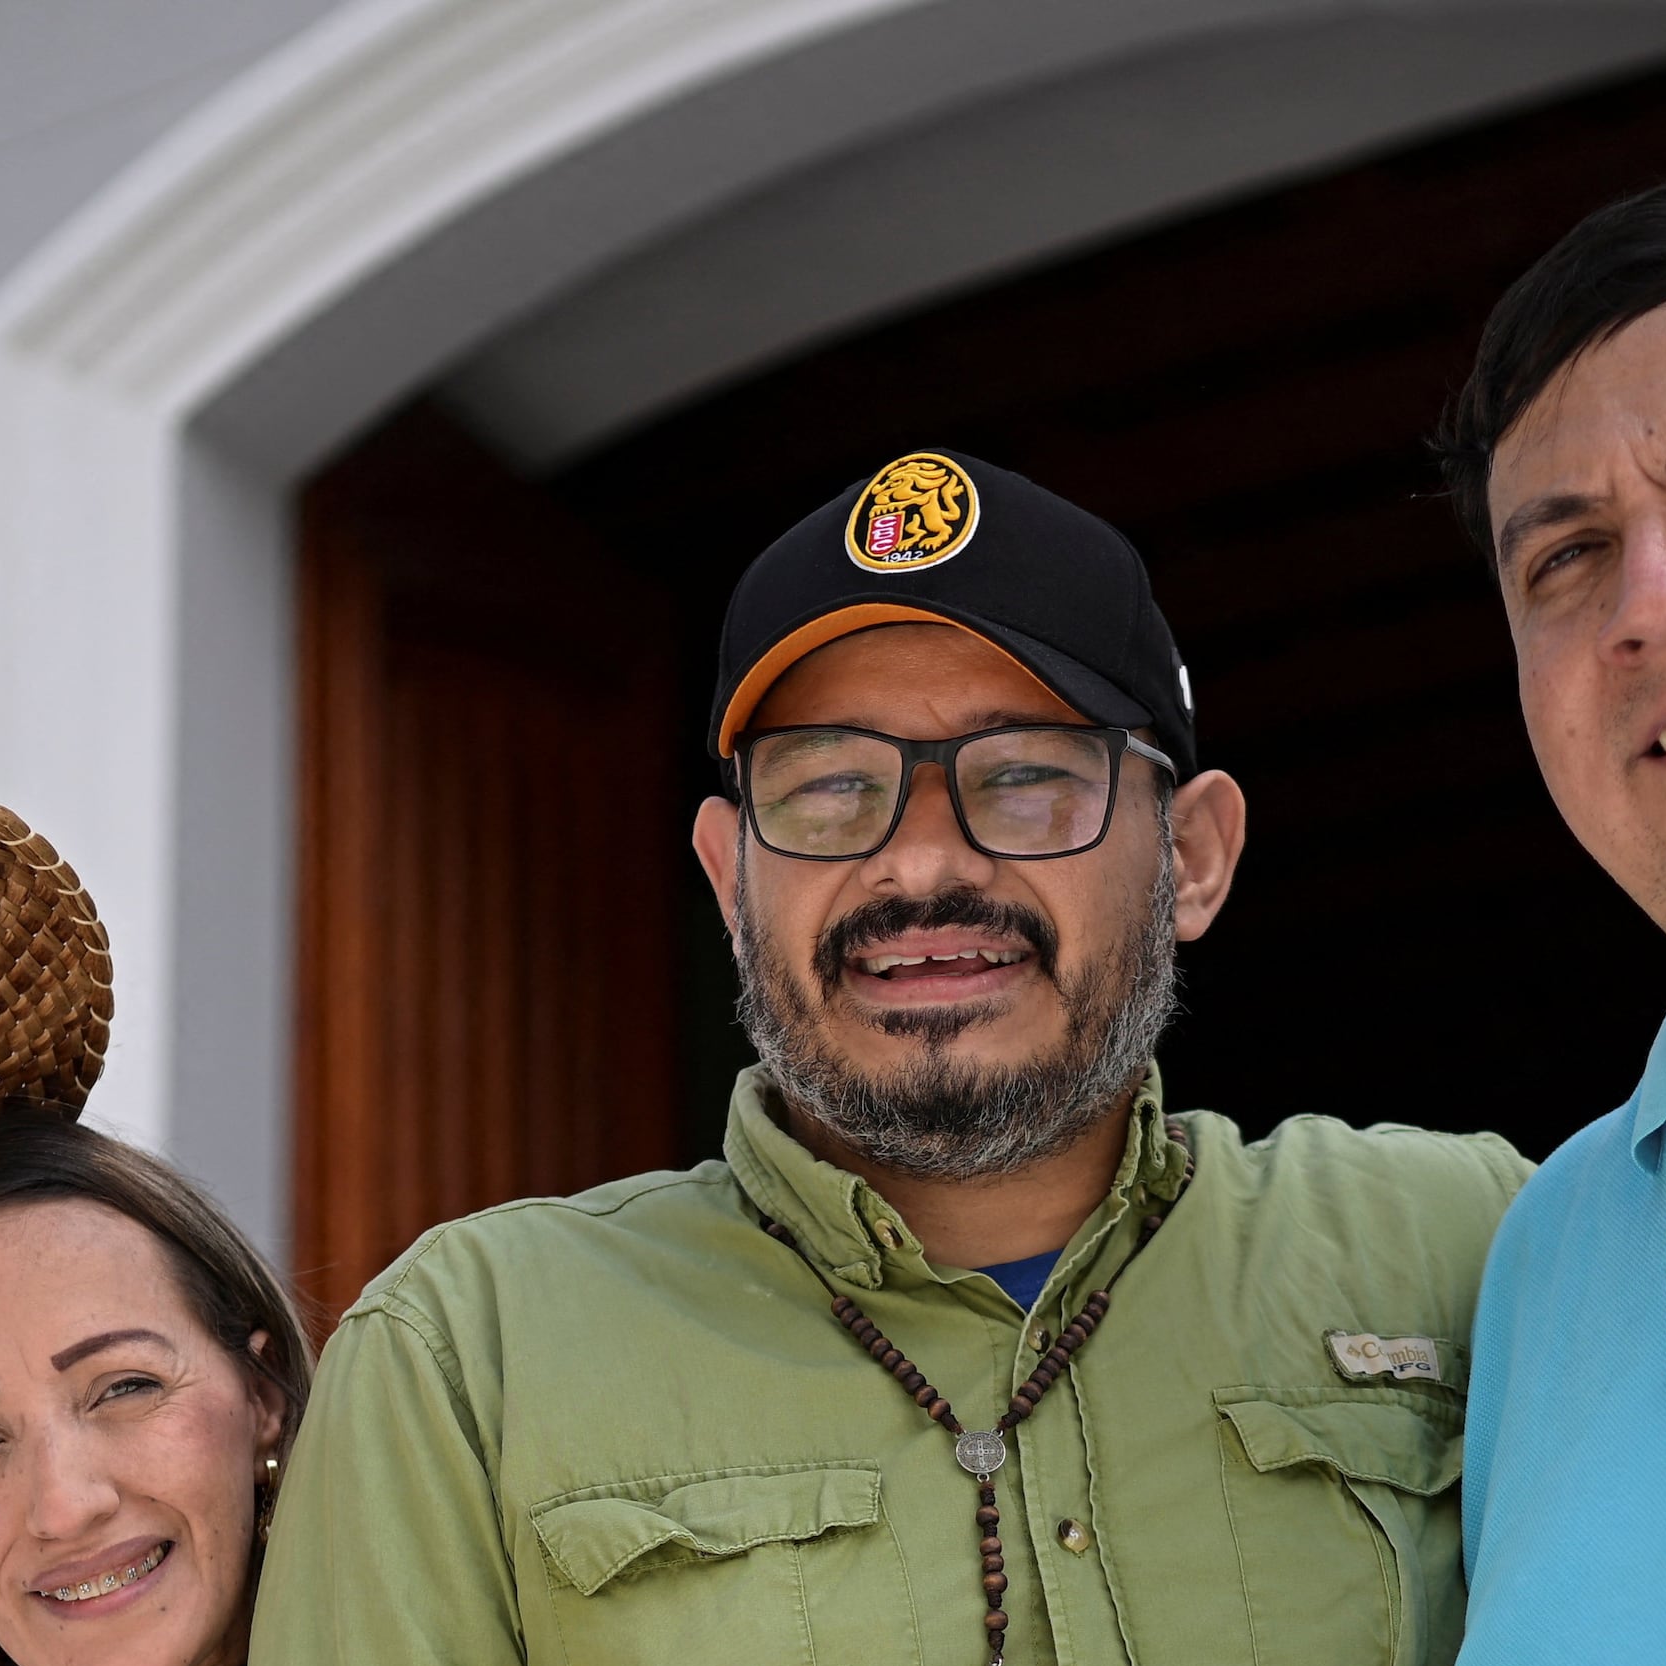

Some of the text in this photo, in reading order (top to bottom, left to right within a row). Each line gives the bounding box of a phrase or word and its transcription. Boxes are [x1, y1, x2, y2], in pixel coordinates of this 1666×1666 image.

[871, 516, 897, 551] CBC
[882, 551, 924, 563] 1942
[1361, 1341, 1429, 1365] Cmbia
